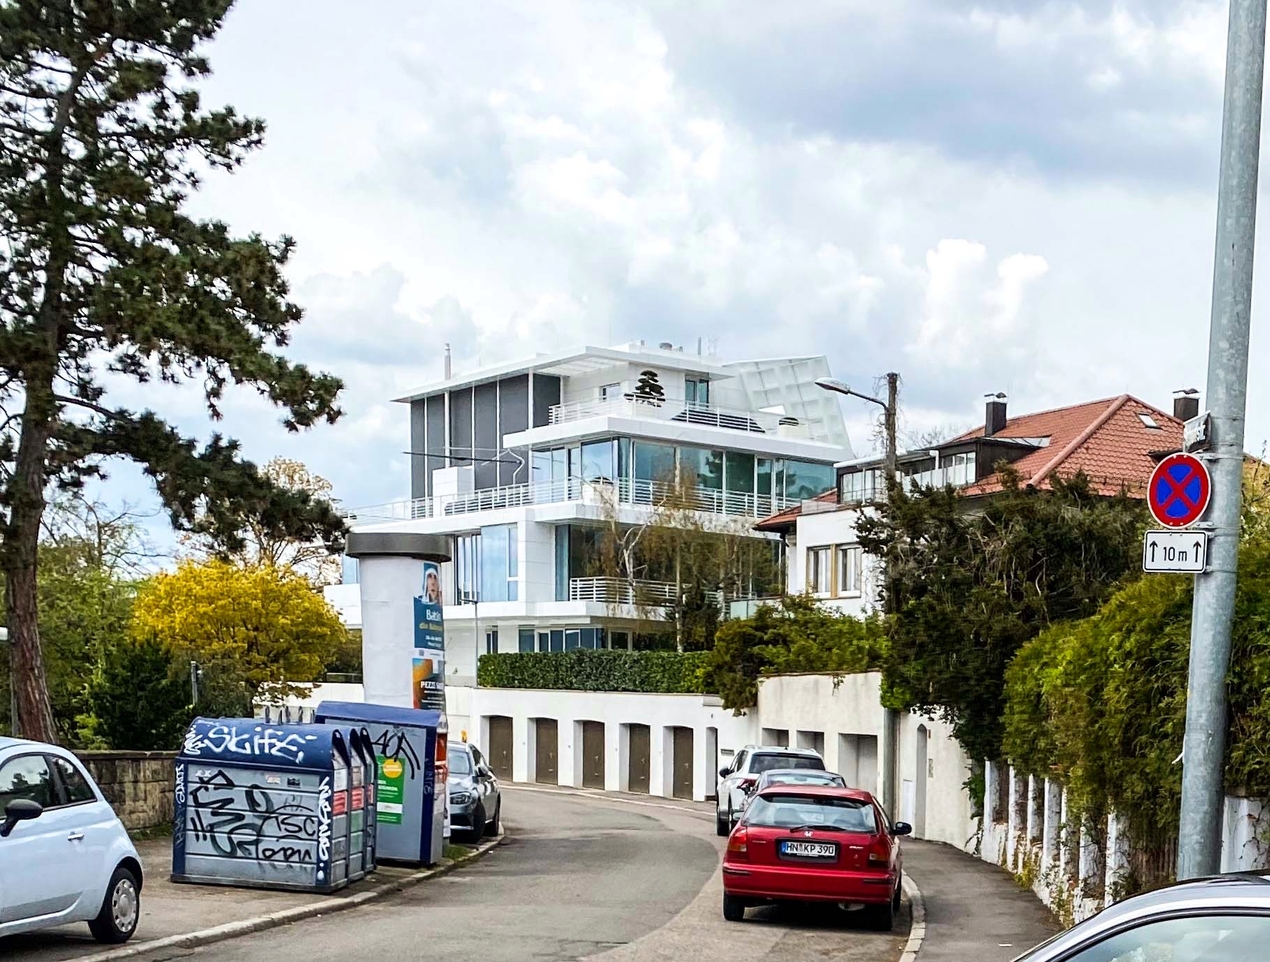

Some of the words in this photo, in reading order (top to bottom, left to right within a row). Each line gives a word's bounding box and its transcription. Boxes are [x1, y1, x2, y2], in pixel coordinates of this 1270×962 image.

[1163, 546, 1175, 562] 10
[1178, 550, 1188, 562] m
[786, 842, 799, 852] HN
[803, 844, 816, 854] KP
[817, 845, 834, 855] 390
